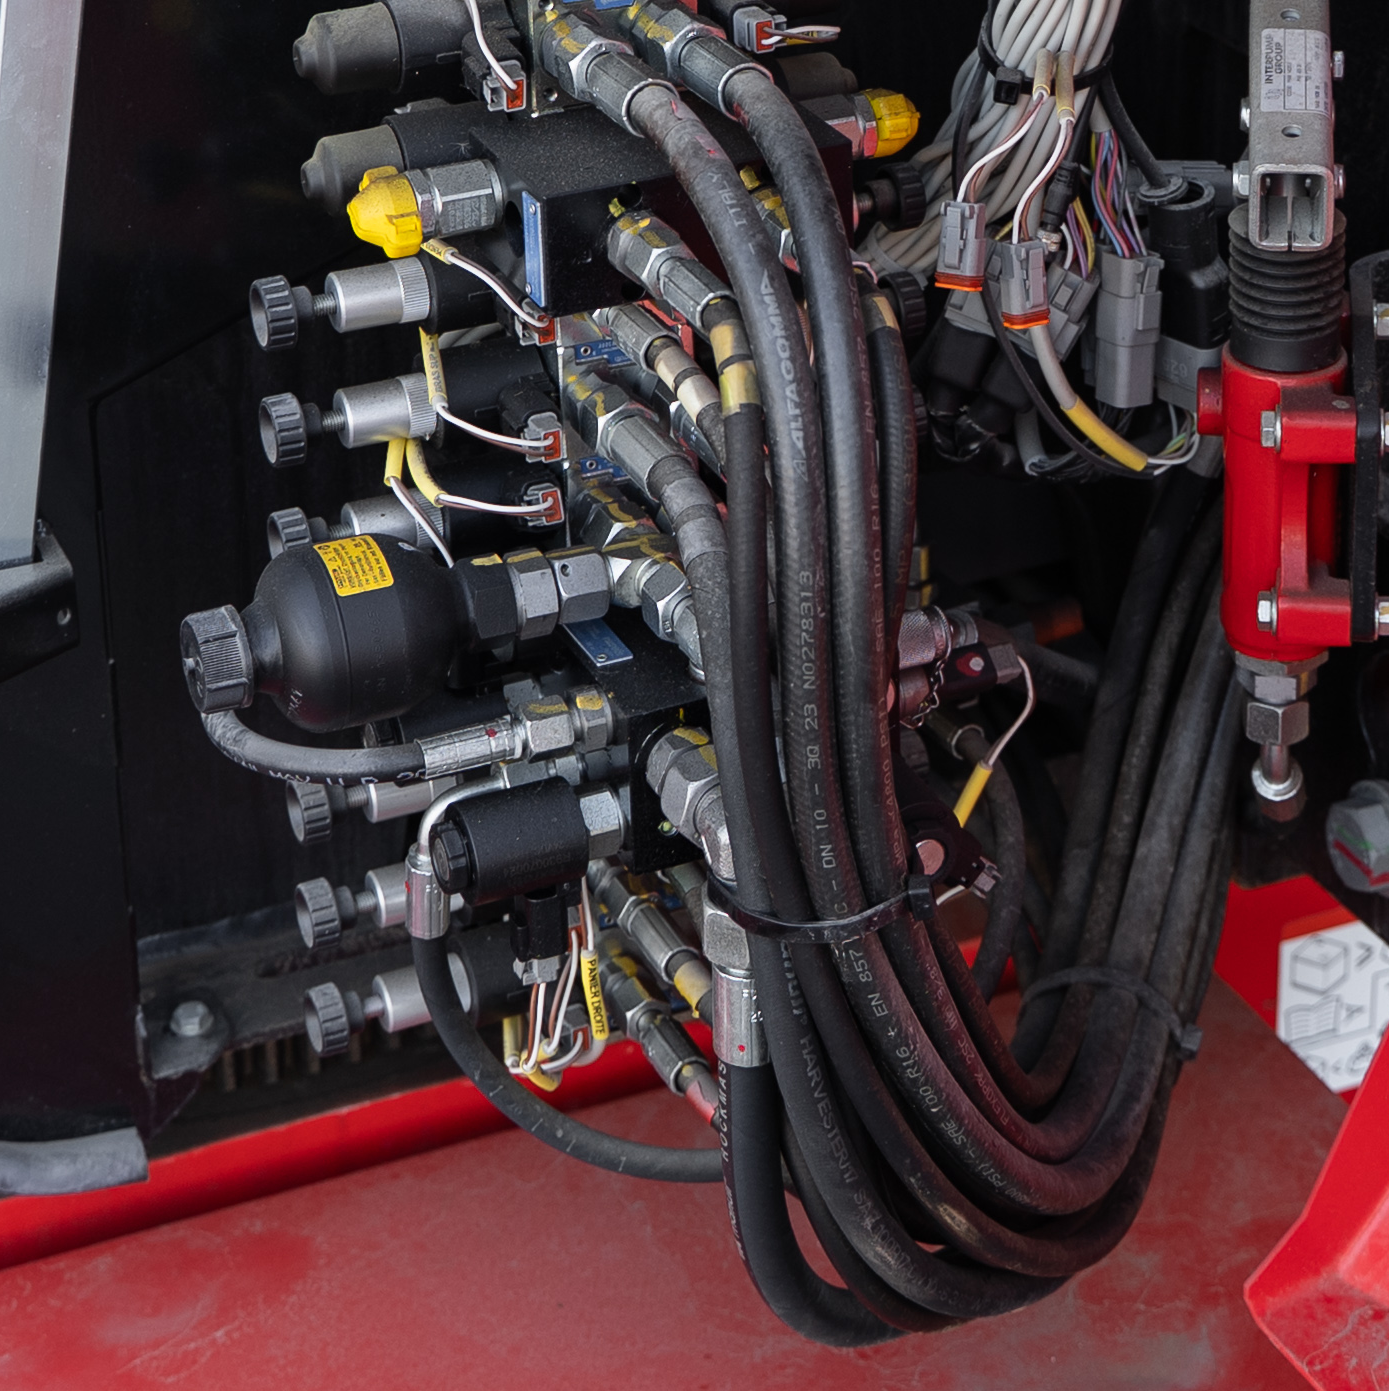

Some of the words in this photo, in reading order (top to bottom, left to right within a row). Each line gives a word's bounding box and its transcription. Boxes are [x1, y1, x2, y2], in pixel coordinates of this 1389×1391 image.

[1264, 33, 1274, 85] INTERPUMP
[1273, 41, 1284, 74] GROUP
[709, 170, 748, 227] ITALY
[872, 548, 883, 588] 100
[804, 702, 819, 731] 23
[815, 809, 827, 832] 10
[822, 839, 837, 869] DN
[587, 959, 598, 998] PANIER
[850, 948, 874, 984] 857
[592, 1000, 604, 1035] DROITE
[871, 991, 893, 1020] EN
